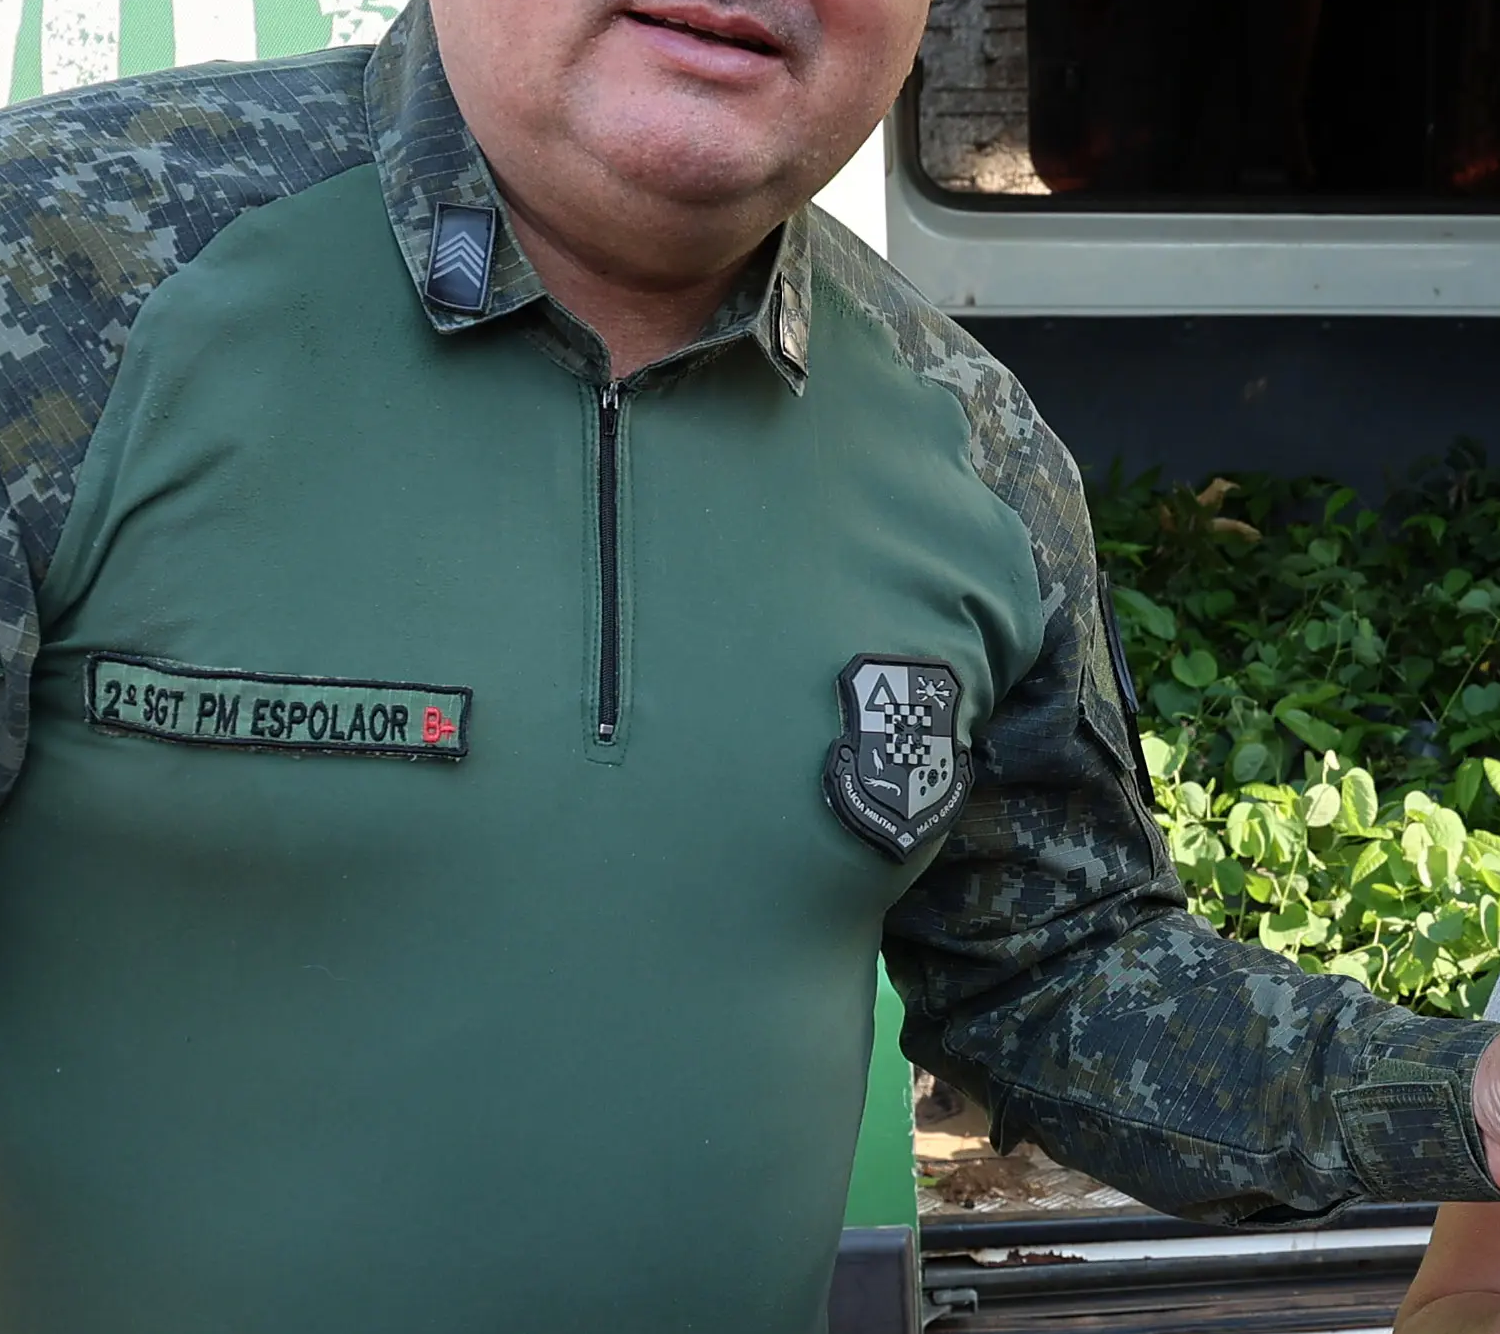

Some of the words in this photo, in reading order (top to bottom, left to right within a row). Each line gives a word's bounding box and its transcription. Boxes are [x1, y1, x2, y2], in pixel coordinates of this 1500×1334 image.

[143, 683, 184, 730] SGT
[196, 692, 241, 736] PM
[250, 698, 409, 743] ESPOLAOR
[421, 705, 457, 745] B+
[864, 807, 898, 835] MILITAR
[916, 814, 939, 836] MATO
[940, 781, 963, 817] GROSSO
